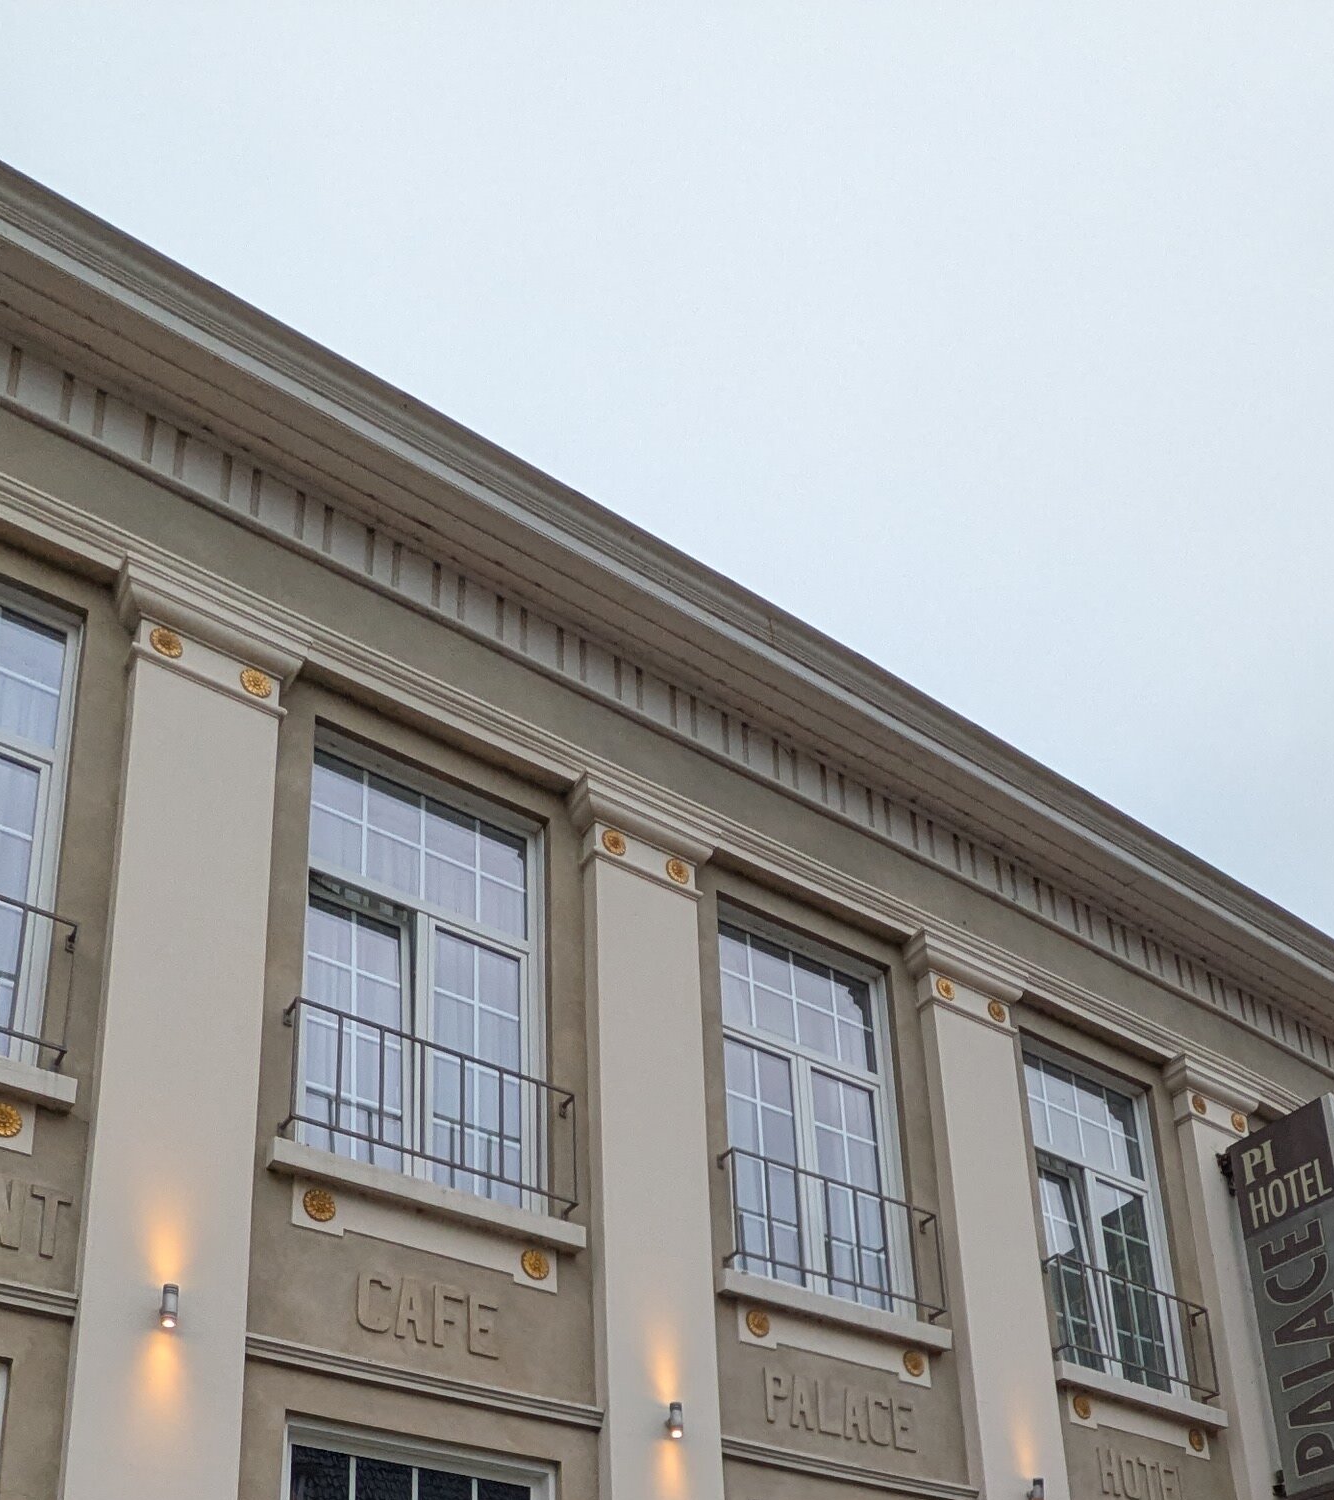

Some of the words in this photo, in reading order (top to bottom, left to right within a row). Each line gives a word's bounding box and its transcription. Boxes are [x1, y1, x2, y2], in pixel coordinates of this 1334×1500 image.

[1241, 1139, 1277, 1186] PI
[1248, 1158, 1334, 1230] HOTEL
[356, 1271, 500, 1360] CAFE
[763, 1366, 918, 1454] PALACE
